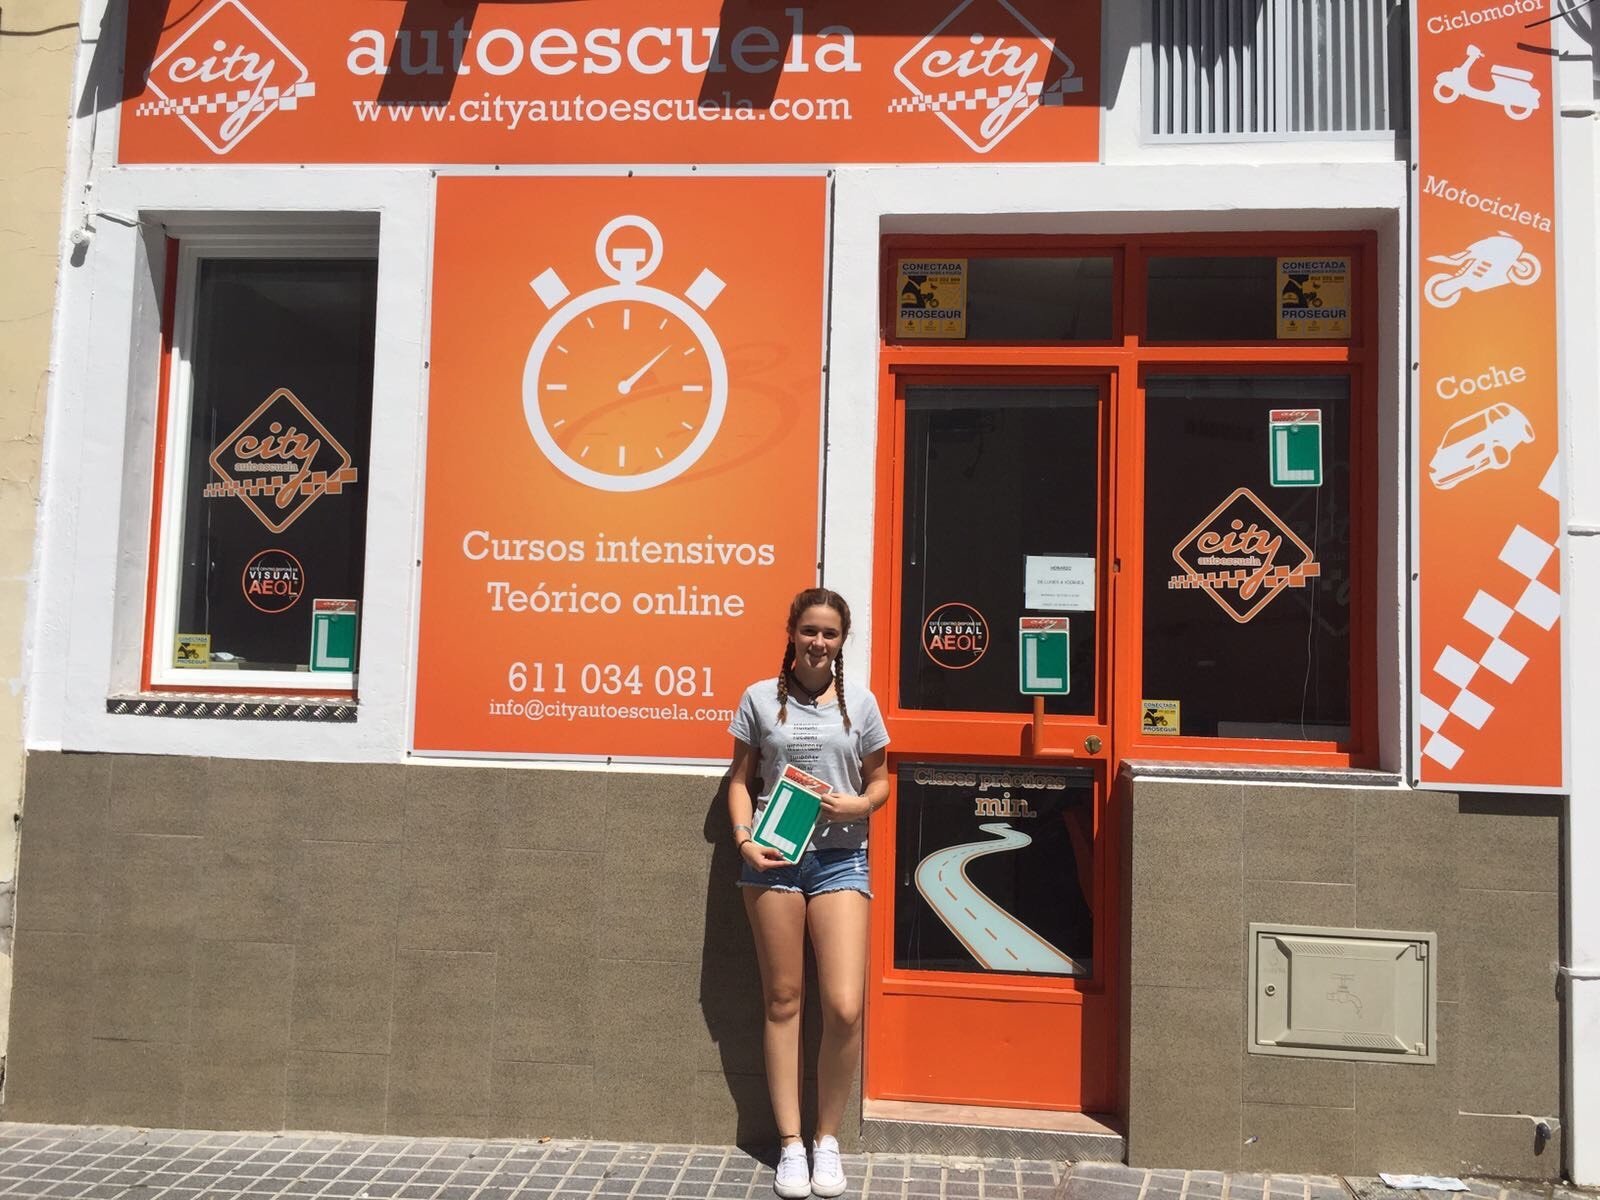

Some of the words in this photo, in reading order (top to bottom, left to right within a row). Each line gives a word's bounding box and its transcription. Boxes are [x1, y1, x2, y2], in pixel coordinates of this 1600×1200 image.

[1427, 0, 1544, 34] Ciclomotor
[346, 8, 862, 77] autoescuela
[168, 40, 276, 142] city
[921, 32, 1039, 141] city
[352, 92, 853, 130] www.cityautoescuela.com
[1423, 175, 1551, 233] Motocicleta
[902, 263, 962, 271] CONECTADA
[1282, 261, 1346, 269] CONECTADA
[901, 310, 962, 319] PROSEGUR
[1282, 309, 1347, 319] PROSEGUR
[1436, 366, 1527, 399] Coche
[234, 421, 321, 509] city
[1276, 430, 1315, 481] L
[462, 530, 586, 562] Cursos
[595, 532, 776, 566] intensivos
[1197, 518, 1283, 600] city
[248, 580, 298, 595] AEOL
[249, 571, 299, 581] VISUAL
[487, 581, 622, 615] Teórico
[632, 586, 745, 617] online
[316, 619, 350, 668] L
[929, 625, 983, 635] VISUAL
[929, 635, 983, 650] AEOL
[507, 661, 567, 694] 611
[580, 663, 643, 696] 034
[654, 665, 714, 698] 081
[1026, 637, 1063, 689] L
[489, 699, 734, 722] info@cityautoescuela.com
[914, 767, 977, 787] Clases
[759, 787, 797, 856] L
[974, 792, 1037, 818] min.
